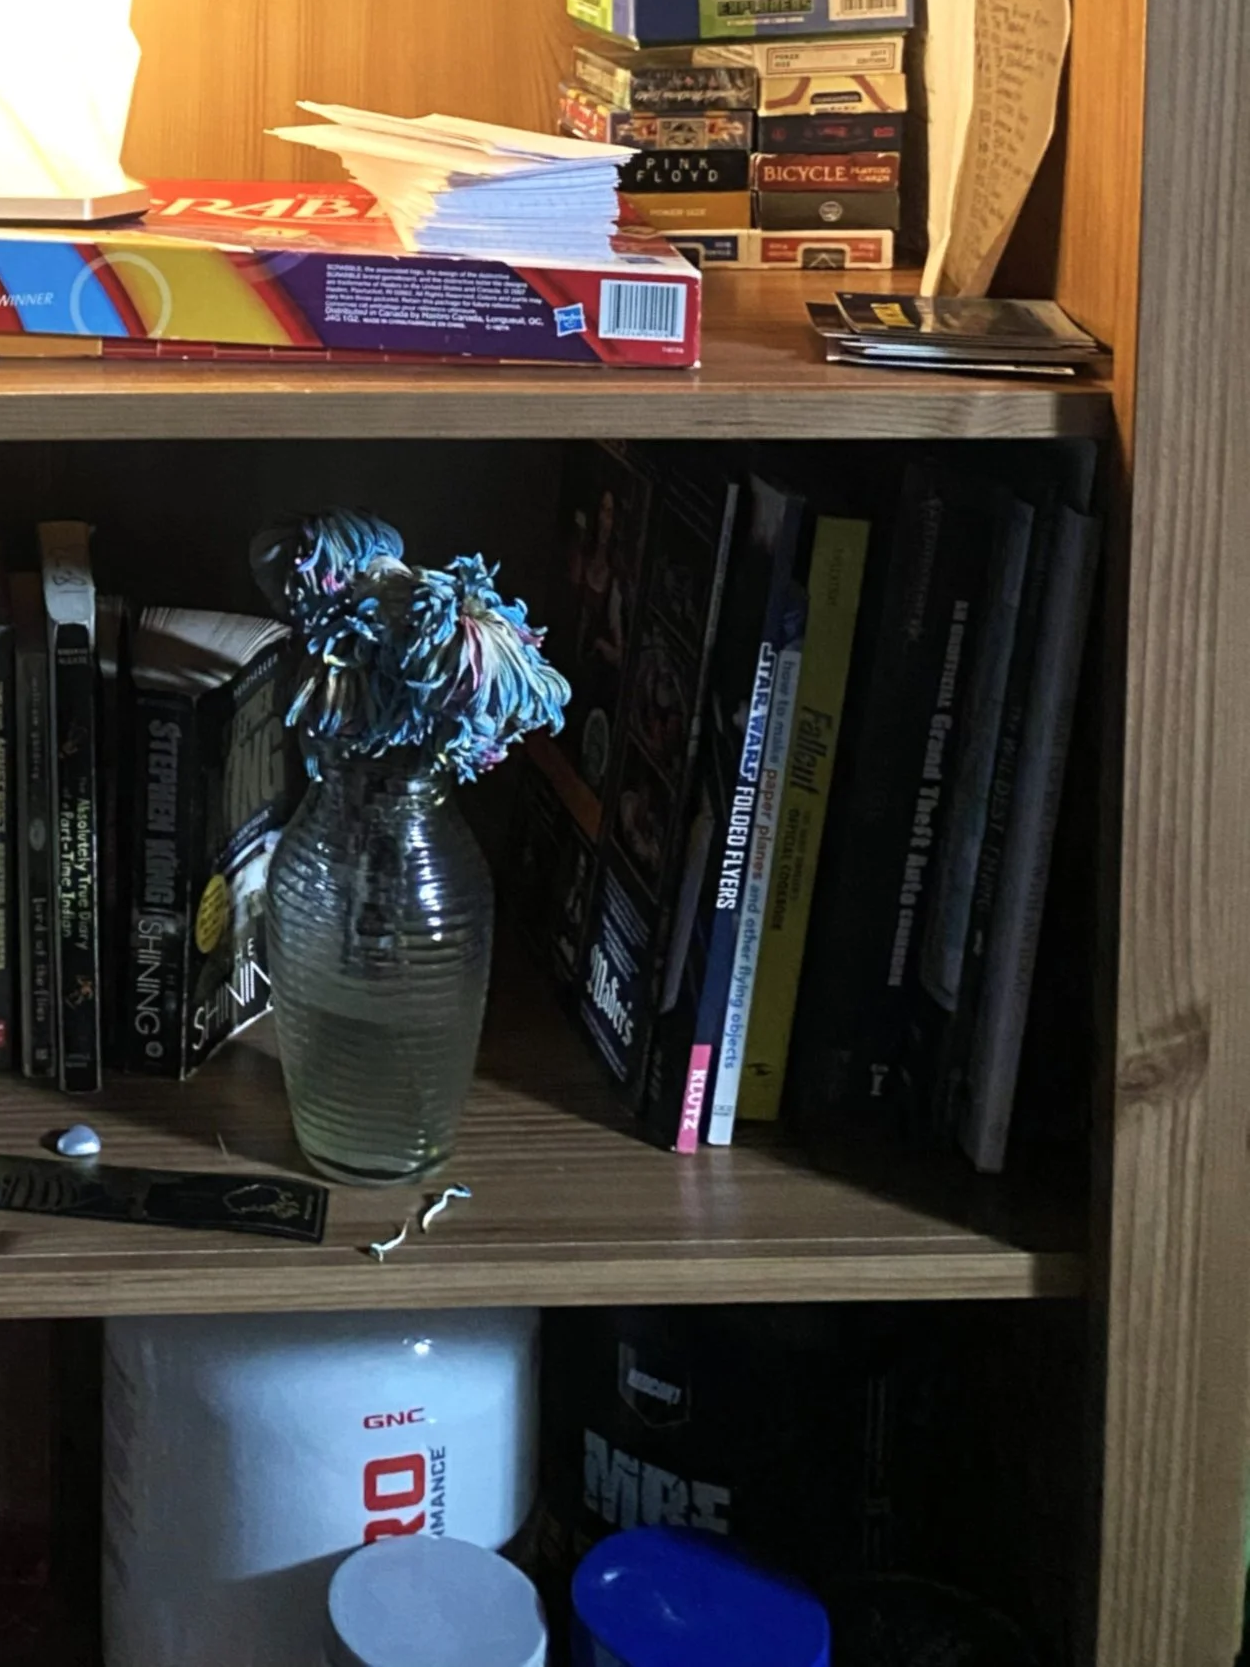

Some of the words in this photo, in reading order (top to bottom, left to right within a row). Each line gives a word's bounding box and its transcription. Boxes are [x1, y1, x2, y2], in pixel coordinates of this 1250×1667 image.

[635, 169, 719, 183] FLOYD
[645, 157, 709, 171] PINK
[763, 165, 849, 182] BICYCLE
[749, 641, 779, 711] STAR
[779, 658, 795, 697] how
[776, 698, 790, 716] to
[738, 712, 767, 782] WARS
[768, 720, 787, 765] make
[789, 704, 834, 796] Fallout
[921, 712, 954, 783] Grand
[146, 718, 183, 832] STEPHEN
[761, 768, 778, 822] paper
[75, 797, 92, 871] Absolutely
[726, 785, 755, 847] FOLDED
[780, 807, 799, 861] OFFICIAL
[909, 785, 941, 848] Theft
[60, 811, 75, 888] Part-Time
[144, 837, 177, 905] KING
[752, 824, 772, 881] planes
[77, 874, 92, 908] True
[715, 849, 745, 910] FLYERS
[747, 884, 762, 914] and
[771, 863, 792, 931] COOKBOOK
[898, 852, 930, 906] Auto
[61, 891, 76, 938] Indian
[74, 911, 91, 951] Diary
[742, 917, 762, 958] other
[133, 919, 164, 1036] SHINING
[729, 962, 754, 1009] flying
[723, 1012, 745, 1069] objects
[683, 1068, 708, 1131] KLUTZ
[363, 1407, 425, 1430] GNC
[363, 1453, 426, 1544] RO
[429, 1446, 446, 1536] MANCE
